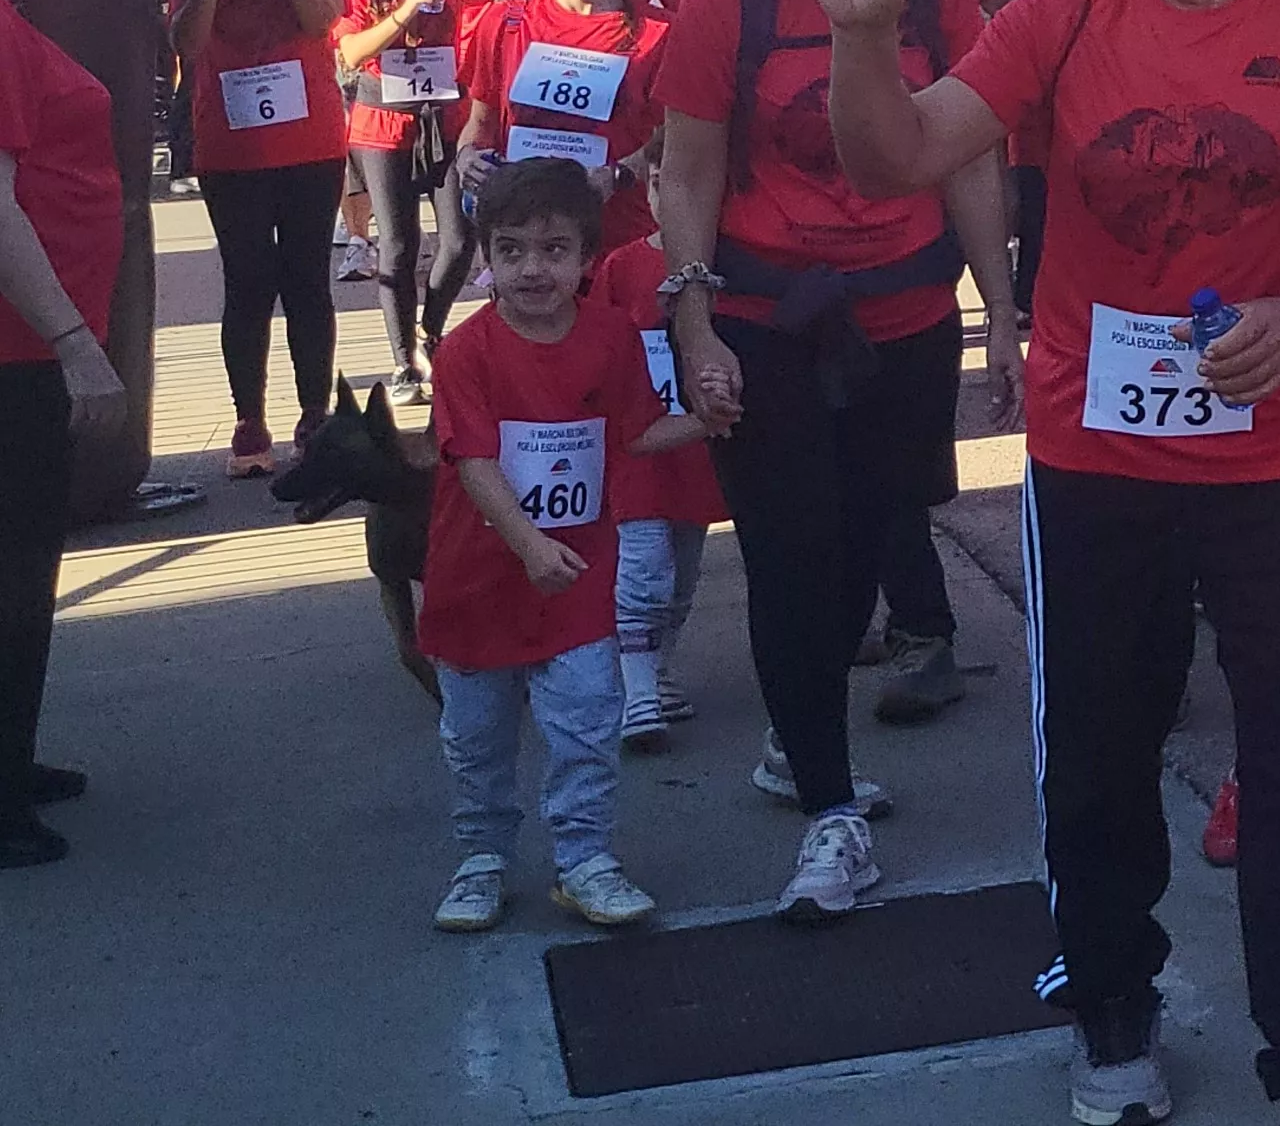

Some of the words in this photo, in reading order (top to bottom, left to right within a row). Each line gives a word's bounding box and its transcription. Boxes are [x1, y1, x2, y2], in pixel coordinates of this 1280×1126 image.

[407, 77, 434, 96] 14
[537, 79, 591, 109] 188
[259, 99, 275, 119] 6
[1119, 384, 1213, 426] 373
[519, 481, 588, 519] 460
